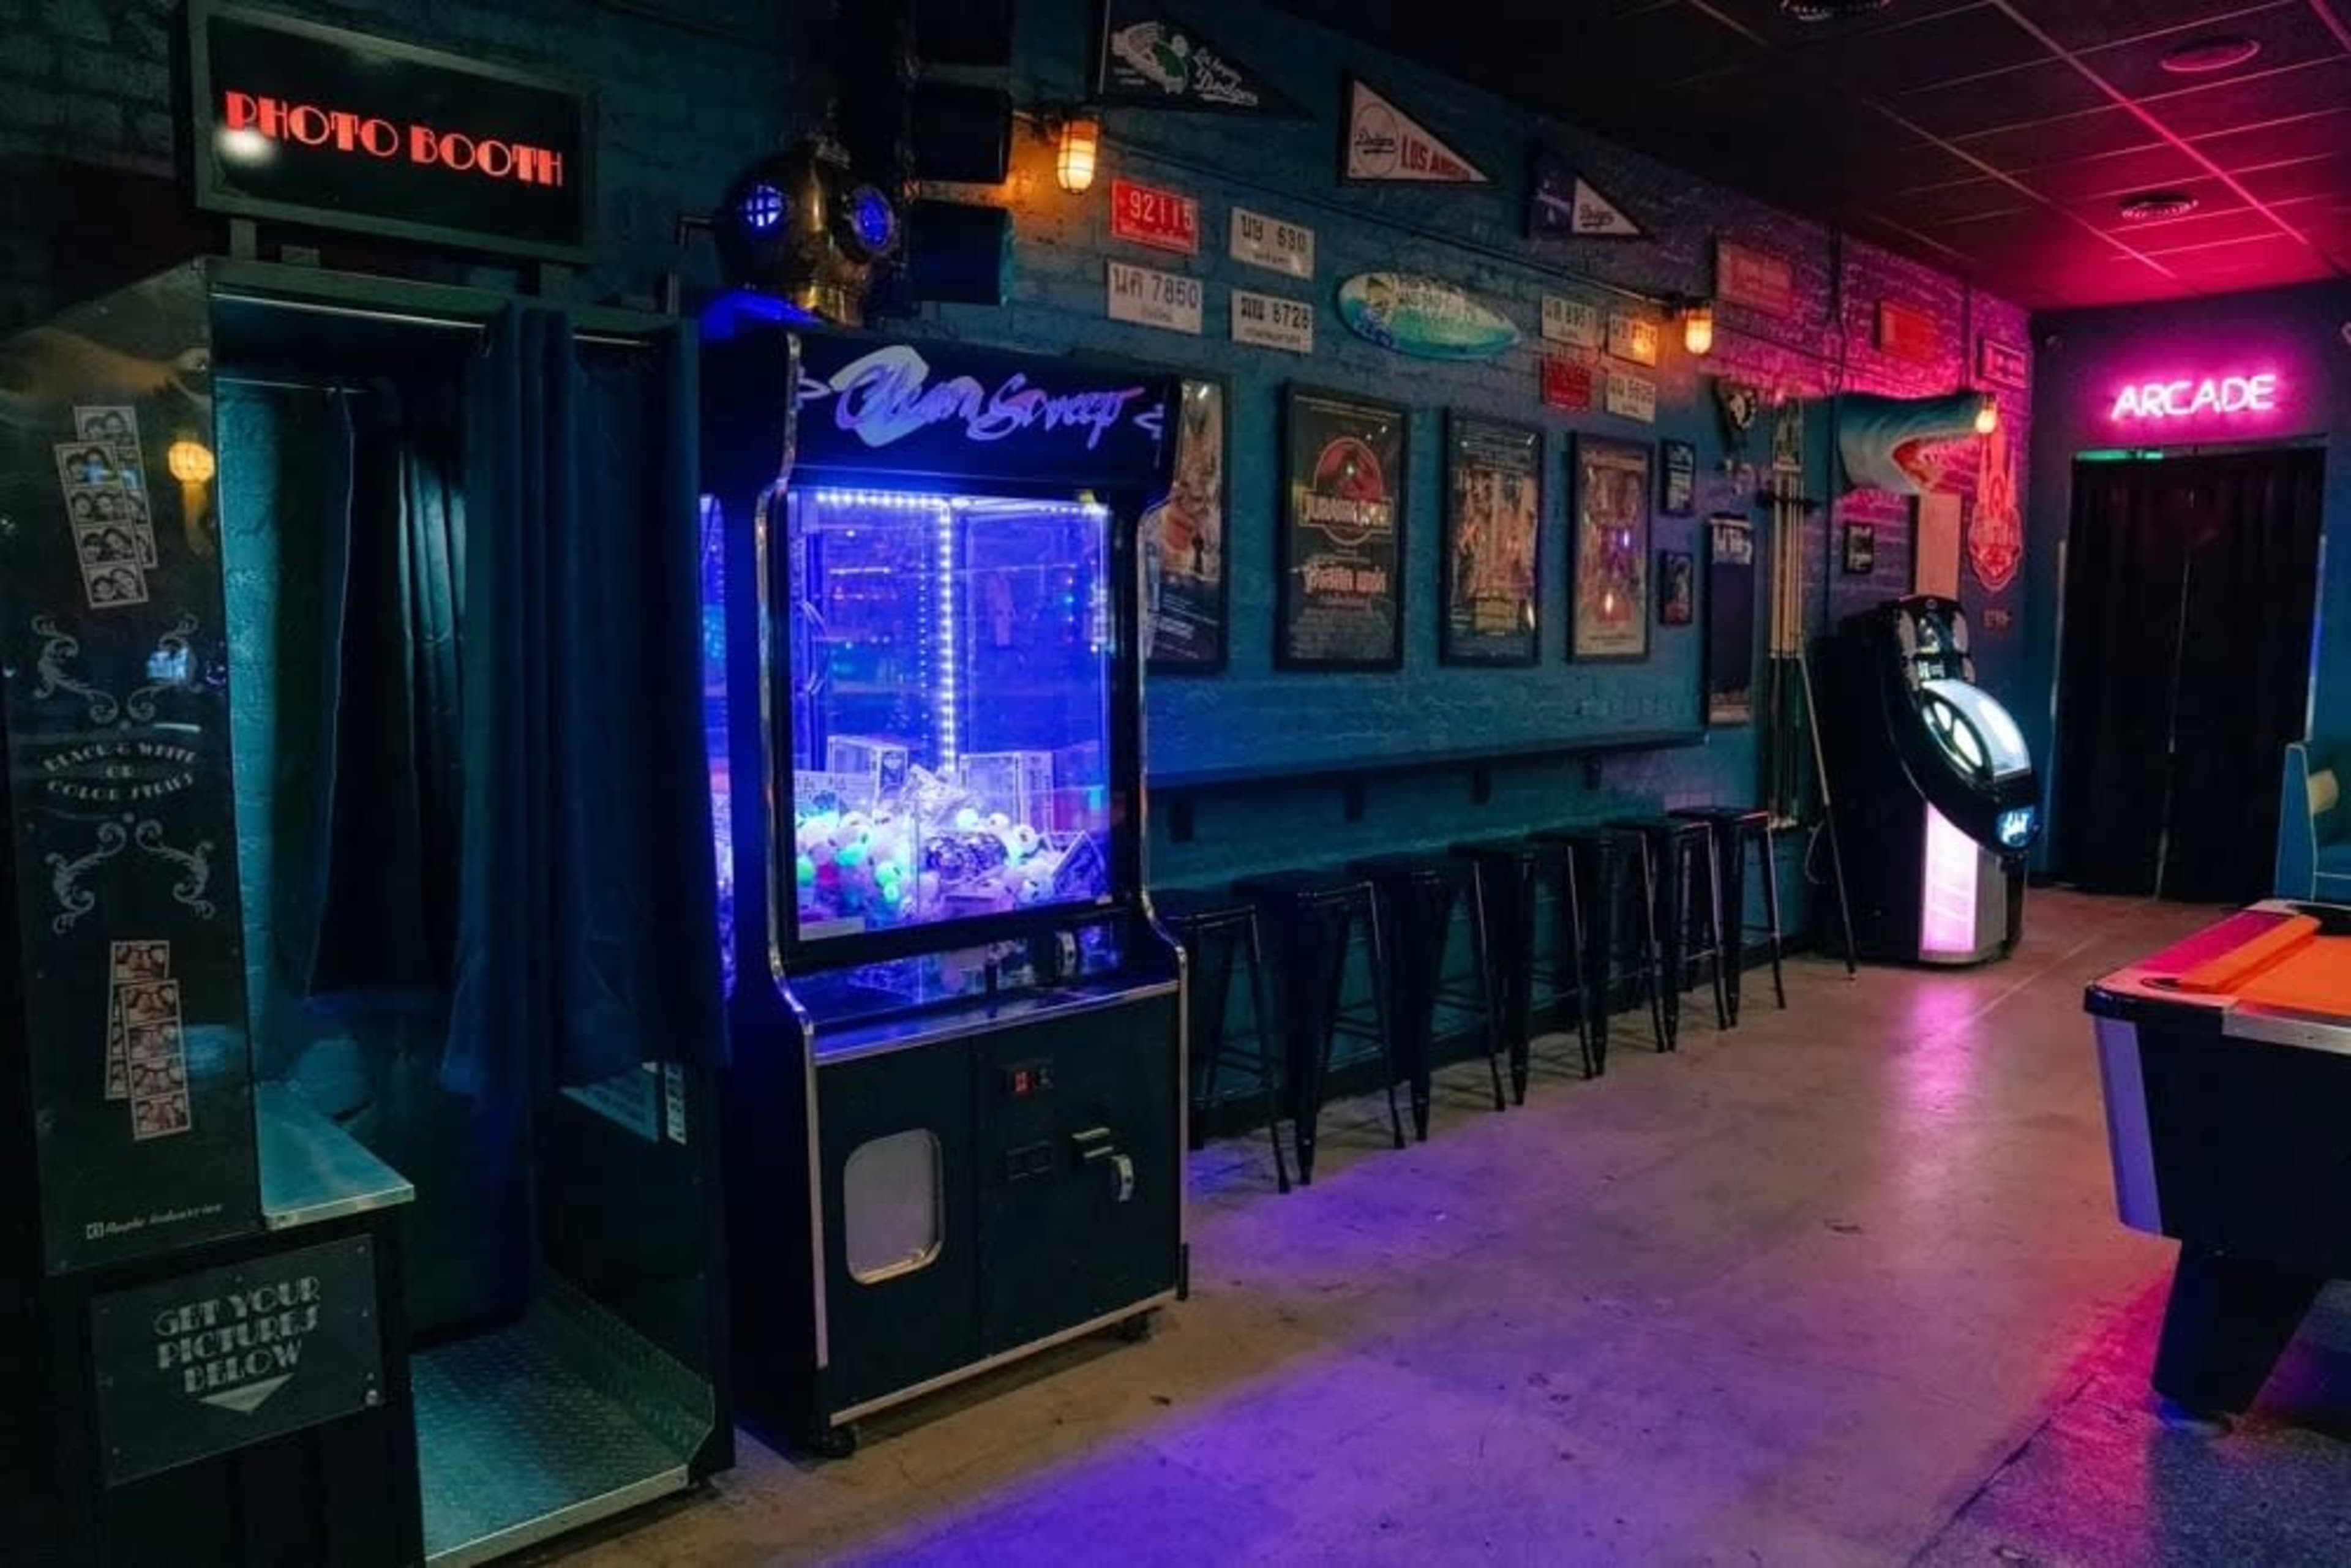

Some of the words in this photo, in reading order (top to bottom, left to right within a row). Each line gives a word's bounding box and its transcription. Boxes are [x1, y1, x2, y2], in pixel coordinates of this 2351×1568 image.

[225, 89, 399, 157] PHOTO
[410, 124, 563, 186] BOOTH
[1401, 135, 1428, 170] LOS
[2110, 374, 2277, 421] ARCADE
[154, 1298, 220, 1337] GET
[227, 1276, 321, 1318] YOUR
[157, 1303, 320, 1370] PICTURES
[185, 1337, 302, 1393] BELOW
